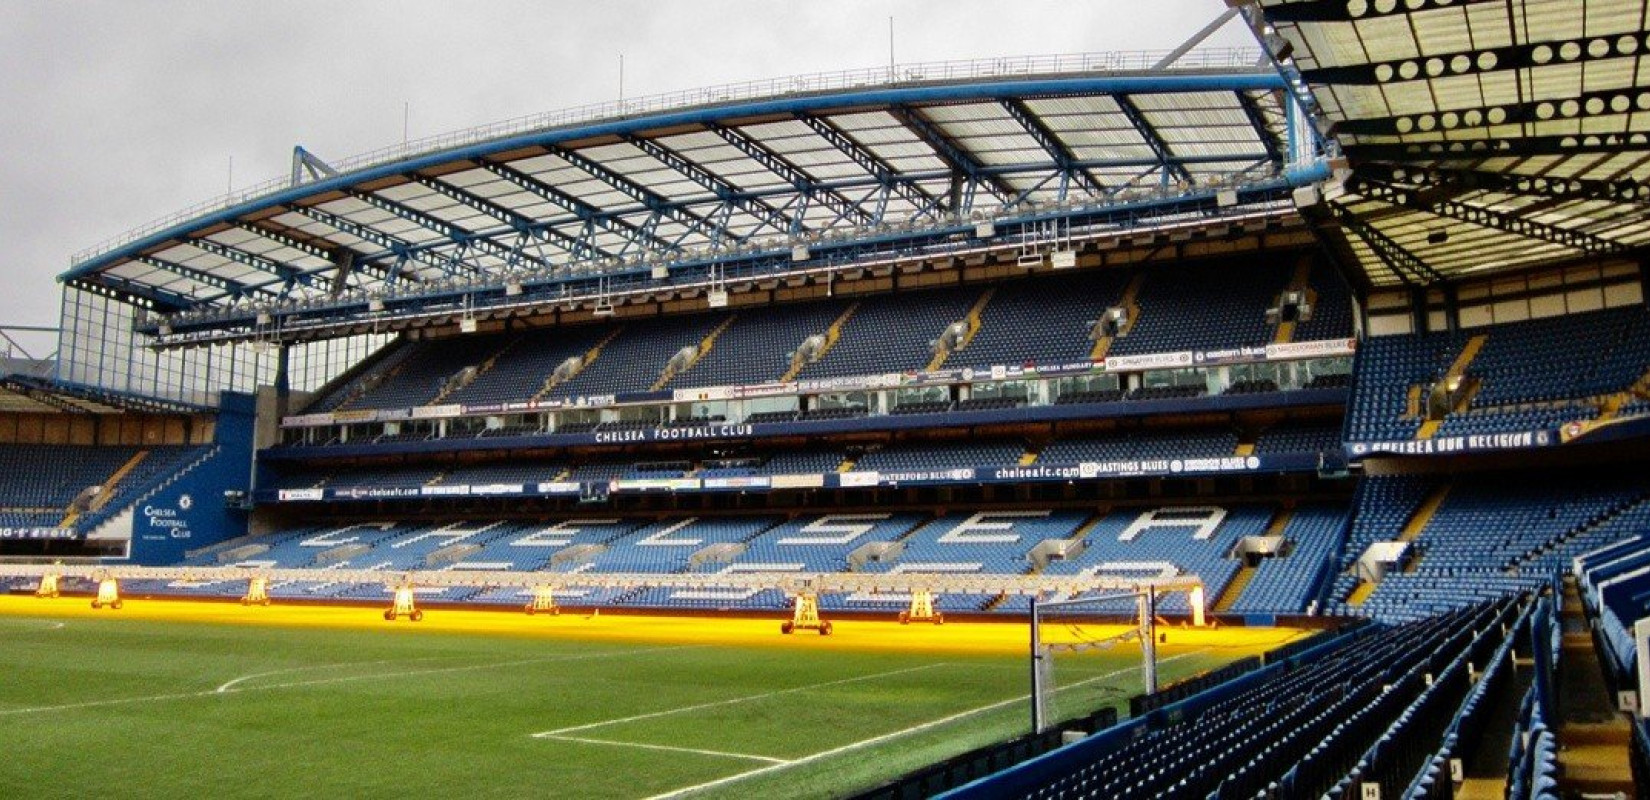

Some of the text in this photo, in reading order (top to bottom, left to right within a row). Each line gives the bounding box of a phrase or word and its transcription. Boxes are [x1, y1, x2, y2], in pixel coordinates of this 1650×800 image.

[1206, 348, 1239, 359] eastern
[595, 424, 753, 443] CHELSEA FOOTBALL CLUB
[1437, 436, 1464, 451] OUR
[1469, 431, 1532, 448] RELIGION
[1140, 459, 1168, 471] BLUES
[995, 467, 1080, 480] chelseafc.com
[369, 486, 419, 496] chelseafc.com
[144, 505, 177, 517] CHELSEA
[150, 517, 187, 528] FOOTBALL
[170, 528, 192, 538] CLUB
